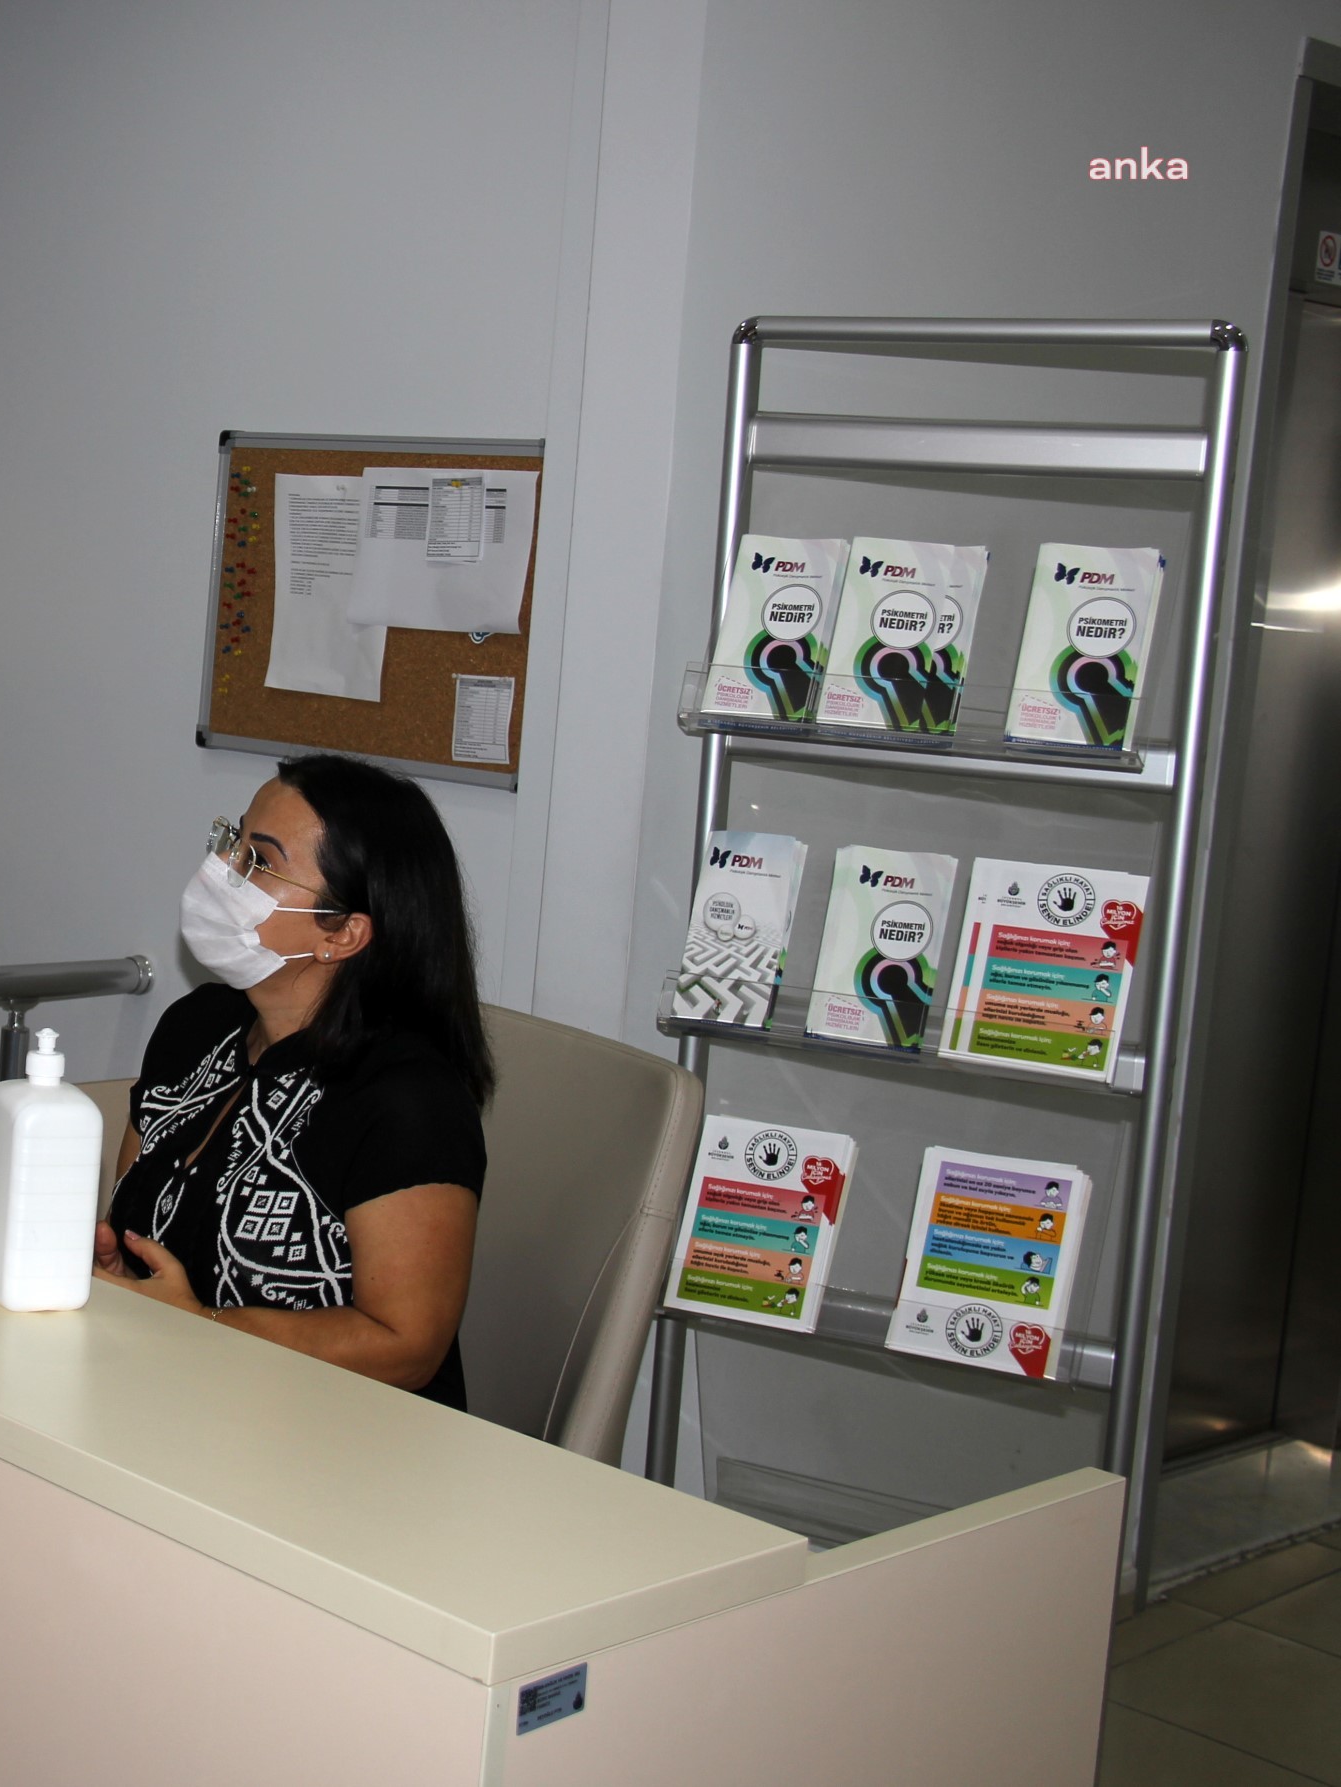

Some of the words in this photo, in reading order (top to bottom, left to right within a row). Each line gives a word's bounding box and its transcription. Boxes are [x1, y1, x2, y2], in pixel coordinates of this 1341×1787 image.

[775, 561, 805, 572] PDM
[884, 565, 916, 578] PDM
[1080, 572, 1115, 585] PDM
[772, 603, 815, 611] PSİKOMETRİ
[881, 609, 927, 620] PSİKOMETRİ
[1078, 617, 1127, 626] PSİKOMETRİ
[731, 855, 763, 869] PDM
[883, 875, 915, 889] PDM
[1042, 876, 1072, 896] SAĞLIKLI
[1074, 877, 1092, 896] HAYAT
[1040, 903, 1060, 924] SENİN
[881, 920, 925, 931] PSİKOMETRİ
[749, 1133, 777, 1150] SAĞLIKLI
[778, 1134, 794, 1151] HAYAT
[747, 1158, 765, 1178] SENİN
[950, 1307, 980, 1325] SAĞLIKLI
[982, 1309, 999, 1327] HAYAT
[948, 1332, 968, 1354] SENİN
